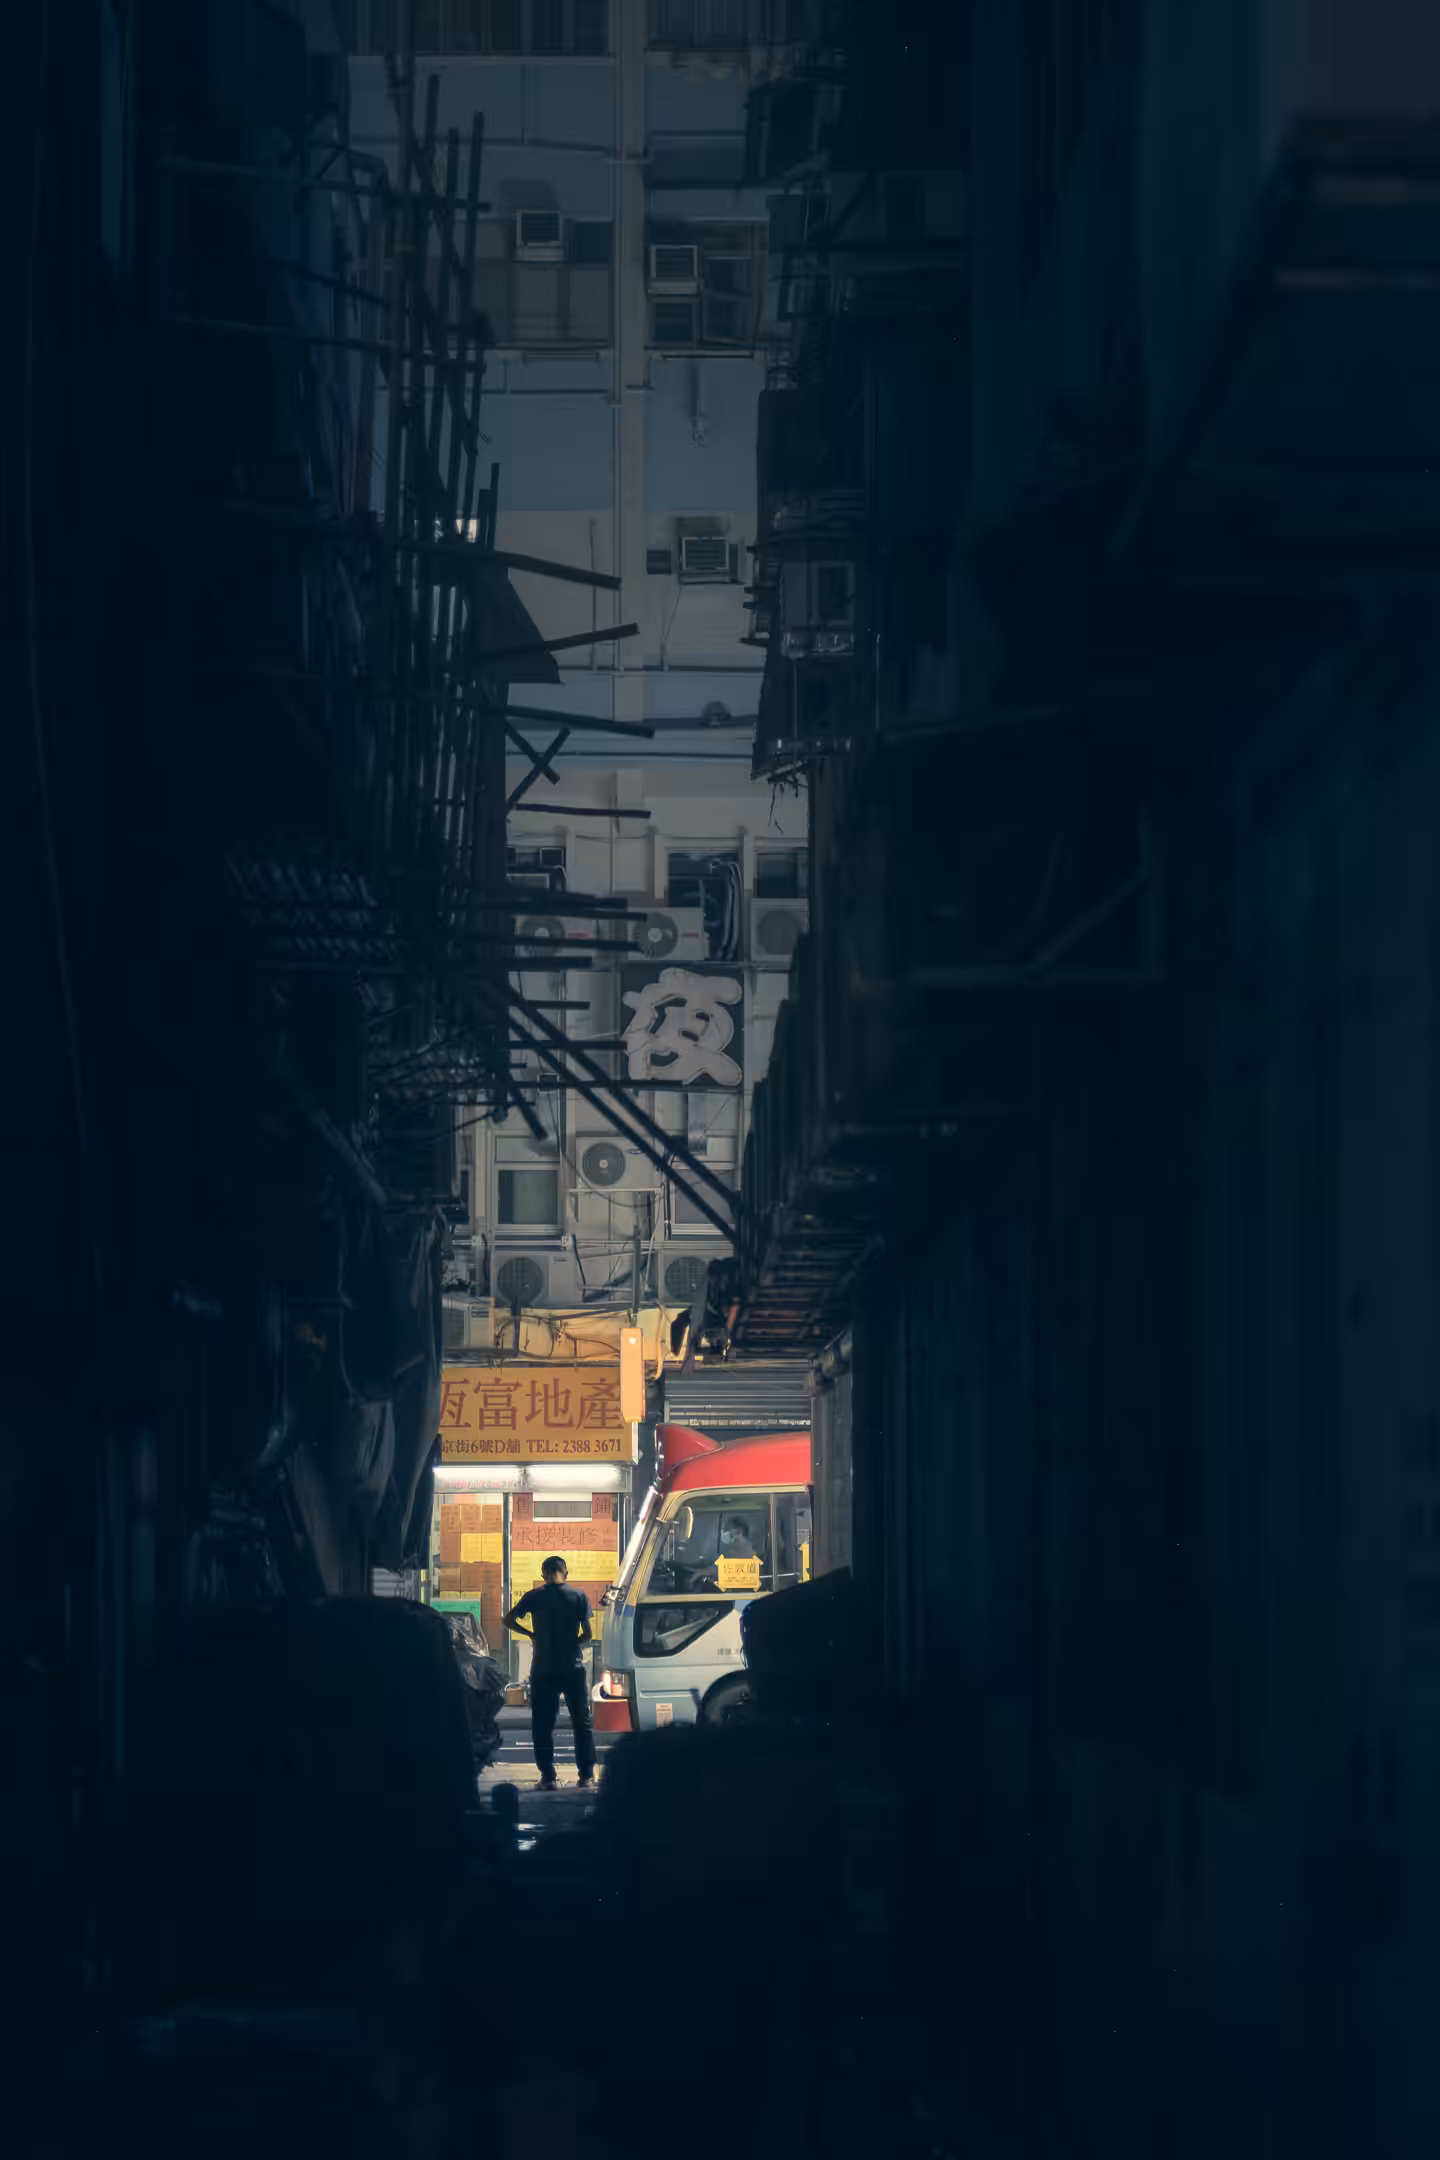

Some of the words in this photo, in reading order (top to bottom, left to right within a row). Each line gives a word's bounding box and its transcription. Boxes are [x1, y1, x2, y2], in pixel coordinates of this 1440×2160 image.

[526, 1439, 560, 1453] TEL:
[562, 1439, 590, 1454] 2388
[593, 1439, 622, 1453] 3671
